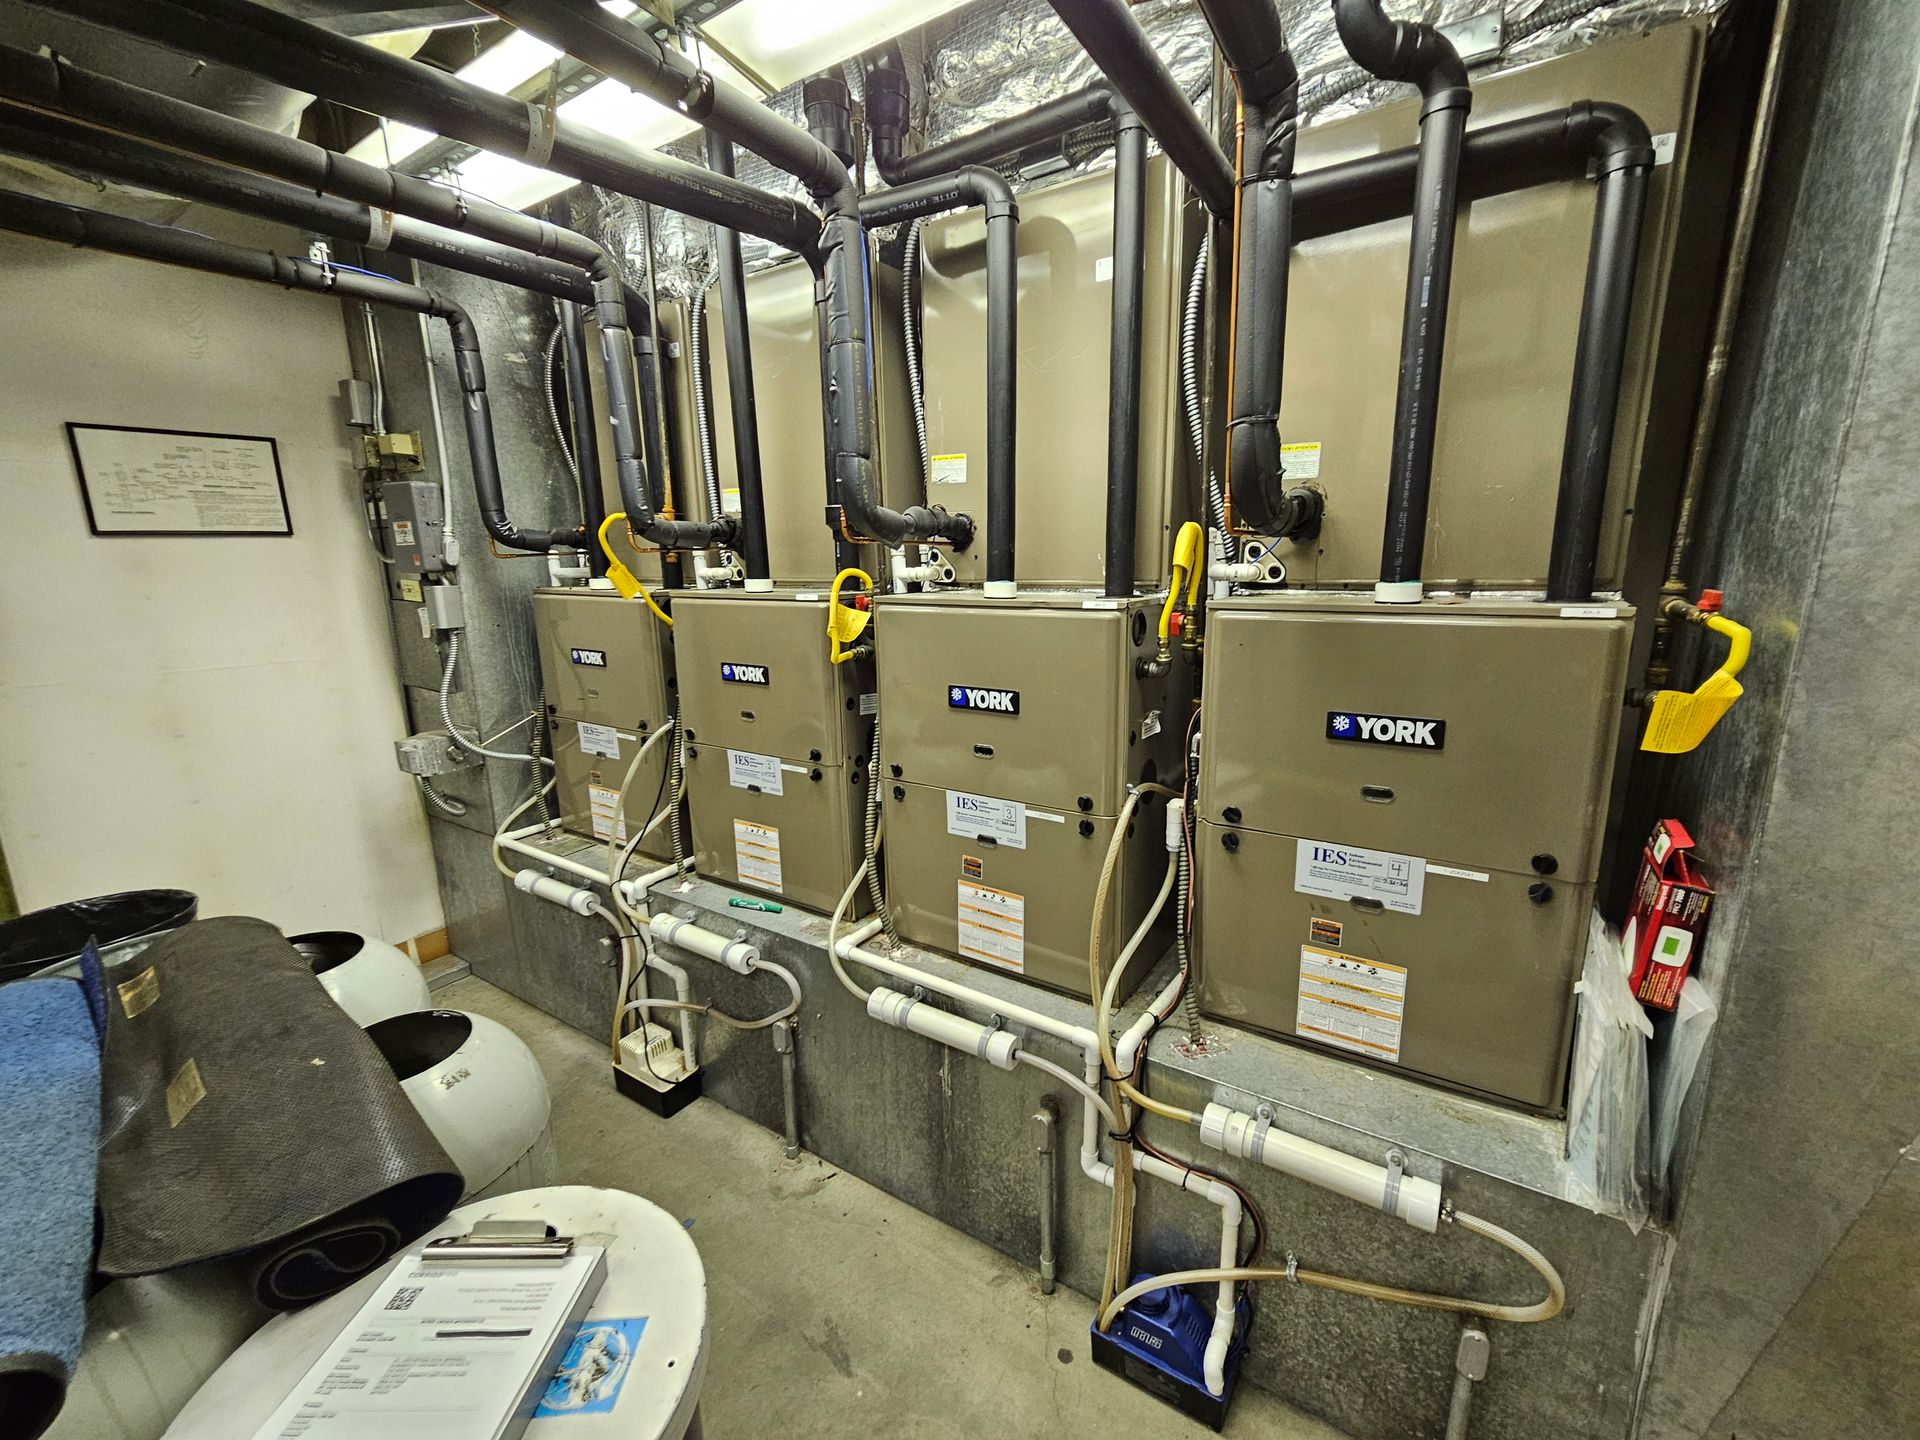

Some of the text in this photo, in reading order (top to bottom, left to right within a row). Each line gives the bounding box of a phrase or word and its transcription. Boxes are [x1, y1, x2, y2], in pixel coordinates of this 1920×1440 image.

[902, 199, 927, 210] PIPE
[578, 650, 604, 665] YORK
[731, 665, 765, 683] YORK
[965, 688, 1014, 712] YORK
[1356, 716, 1437, 746] YORK
[734, 754, 750, 767] IES
[956, 796, 979, 811] IES
[1006, 808, 1013, 820] 3
[1312, 847, 1347, 866] IES
[1391, 863, 1403, 877] 4
